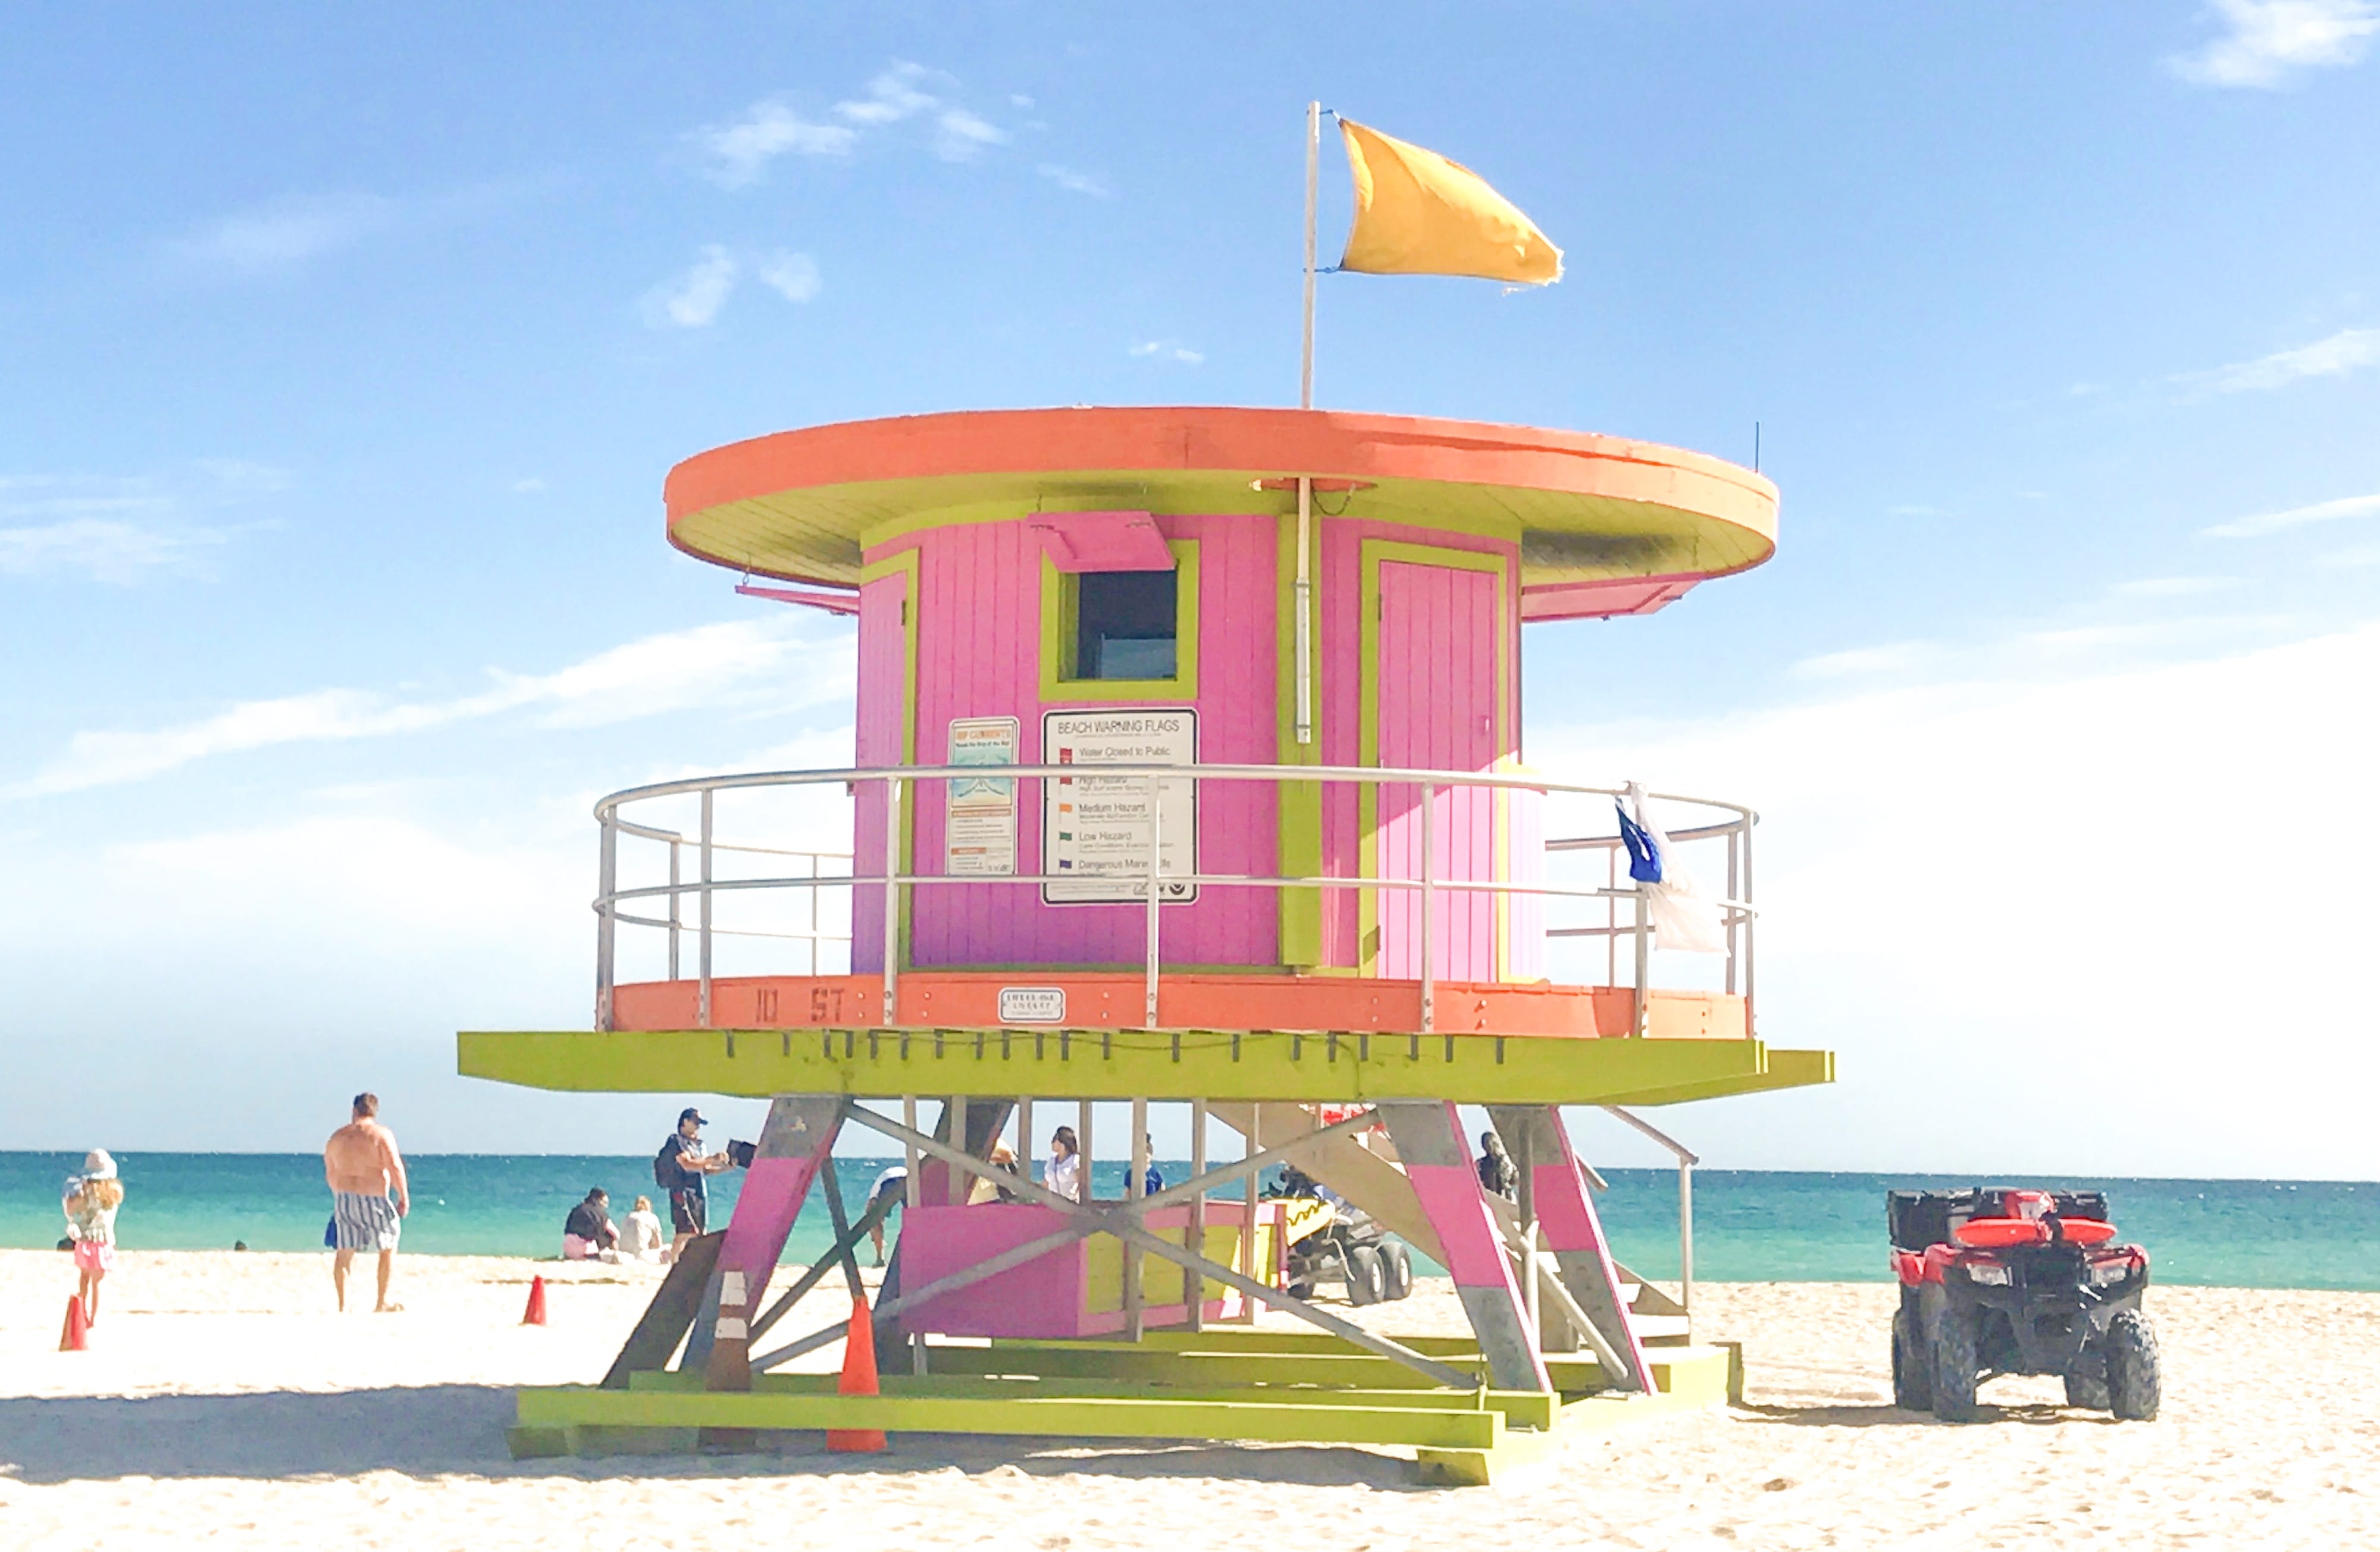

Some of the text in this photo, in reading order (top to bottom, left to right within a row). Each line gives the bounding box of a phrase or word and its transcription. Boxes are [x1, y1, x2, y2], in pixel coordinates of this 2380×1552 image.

[1057, 719, 1180, 734] BEACH WARNING FLAGS
[1079, 745, 1171, 757] Water Closed to Public
[1079, 802, 1146, 813] Medium Hazard
[1079, 831, 1132, 841] Low Hazard
[1078, 860, 1123, 871] Dangerous
[756, 987, 845, 1023] 10 ST
